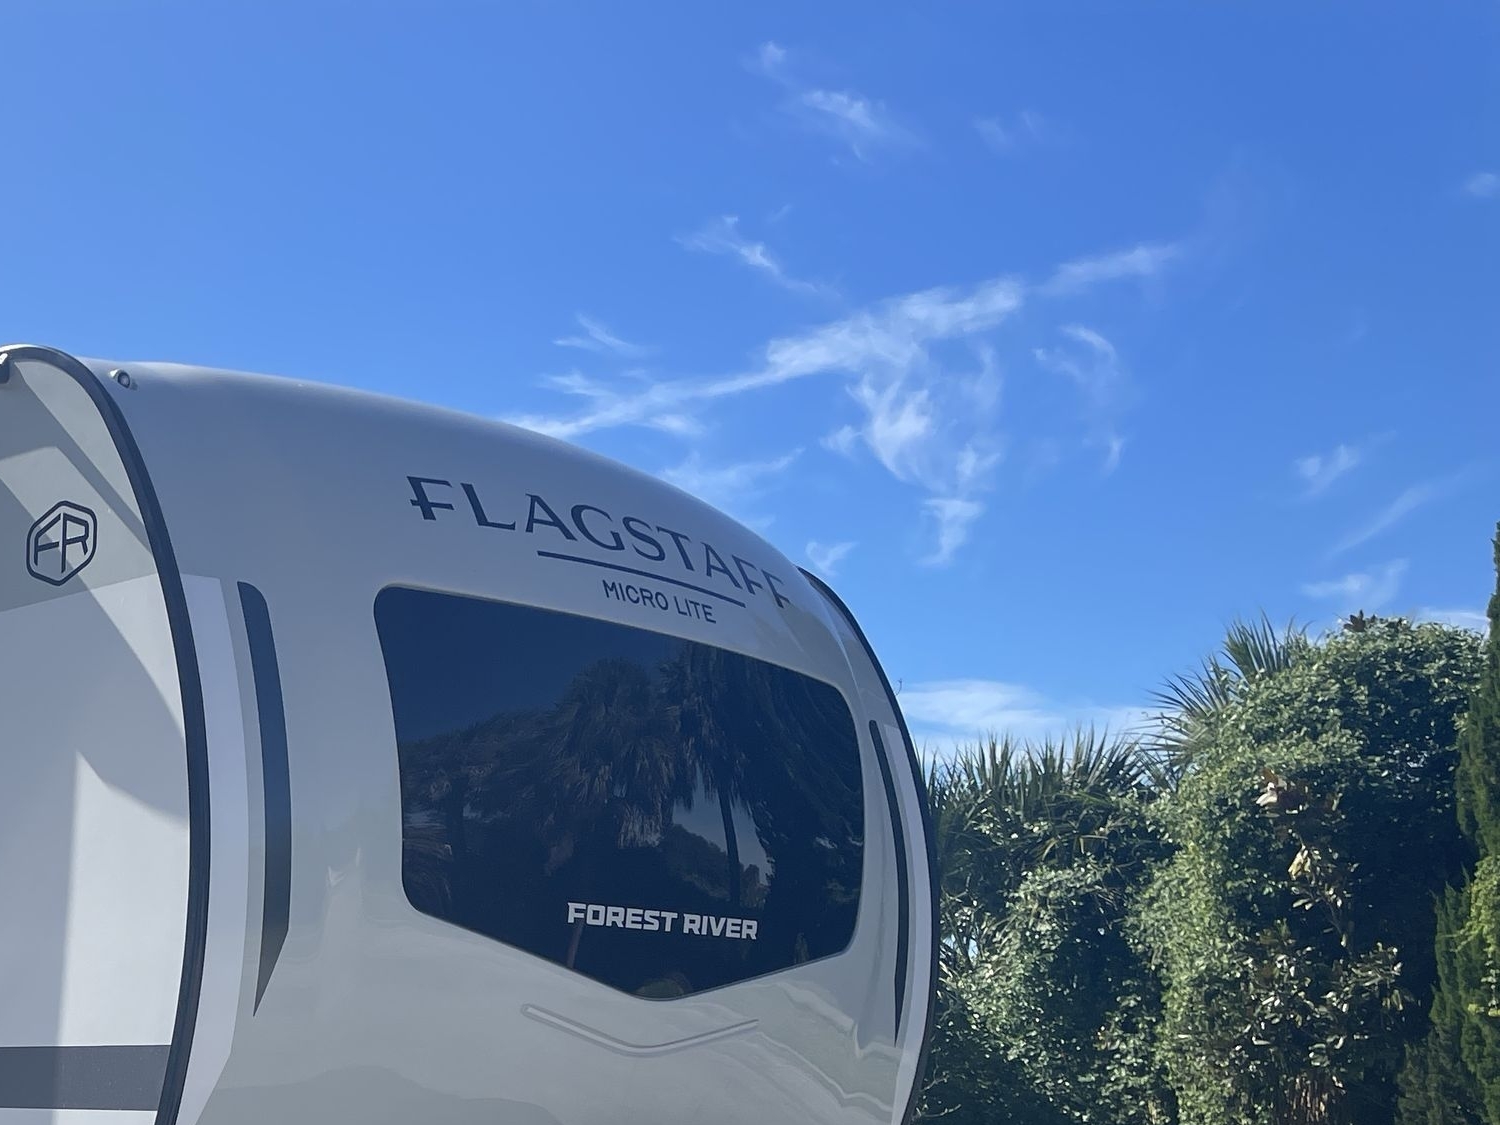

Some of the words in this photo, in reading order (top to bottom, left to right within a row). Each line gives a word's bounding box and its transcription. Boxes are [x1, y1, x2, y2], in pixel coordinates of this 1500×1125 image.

[406, 475, 791, 608] FLAGSTAFF
[602, 579, 668, 611] MICRO
[677, 593, 716, 623] LITE
[567, 902, 677, 932] FOREST
[683, 913, 758, 940] RIVER
